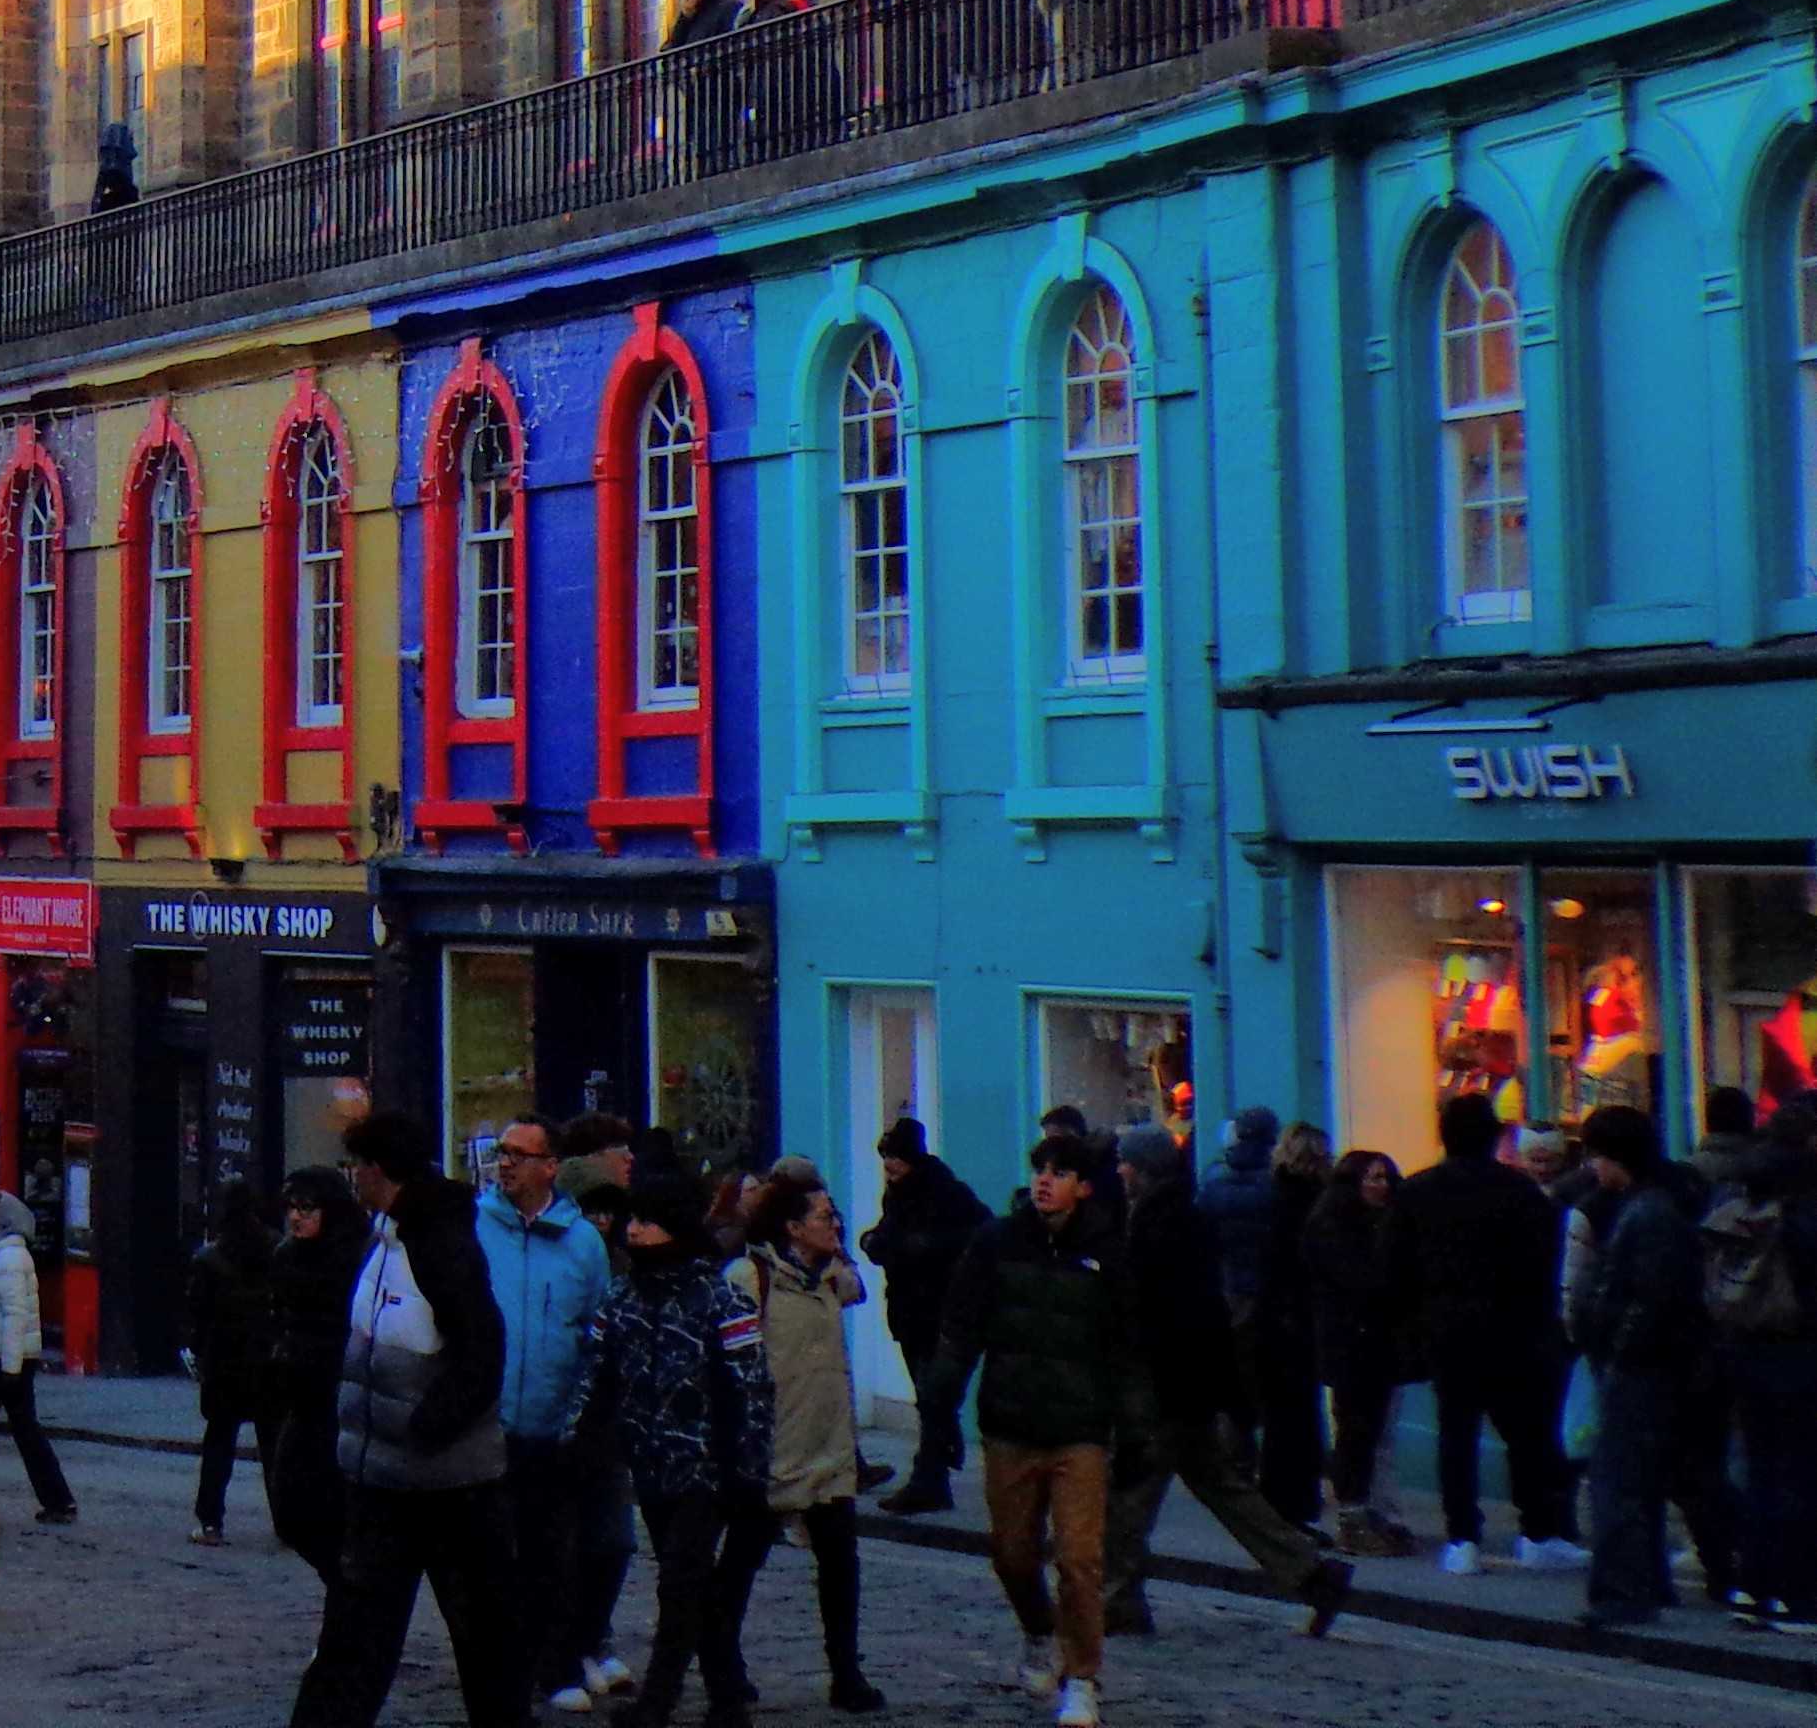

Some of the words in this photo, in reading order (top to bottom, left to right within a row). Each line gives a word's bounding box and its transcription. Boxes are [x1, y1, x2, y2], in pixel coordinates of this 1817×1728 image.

[1446, 745, 1634, 799] SWISH
[1, 895, 52, 927] ELEPHANT
[53, 898, 84, 929] HOUSE
[148, 903, 186, 933] THE
[191, 904, 271, 936] WHISKY
[277, 906, 334, 938] SHOP
[309, 999, 344, 1013] THE
[293, 1025, 363, 1040] WHISKY
[303, 1050, 351, 1065] SHOP
